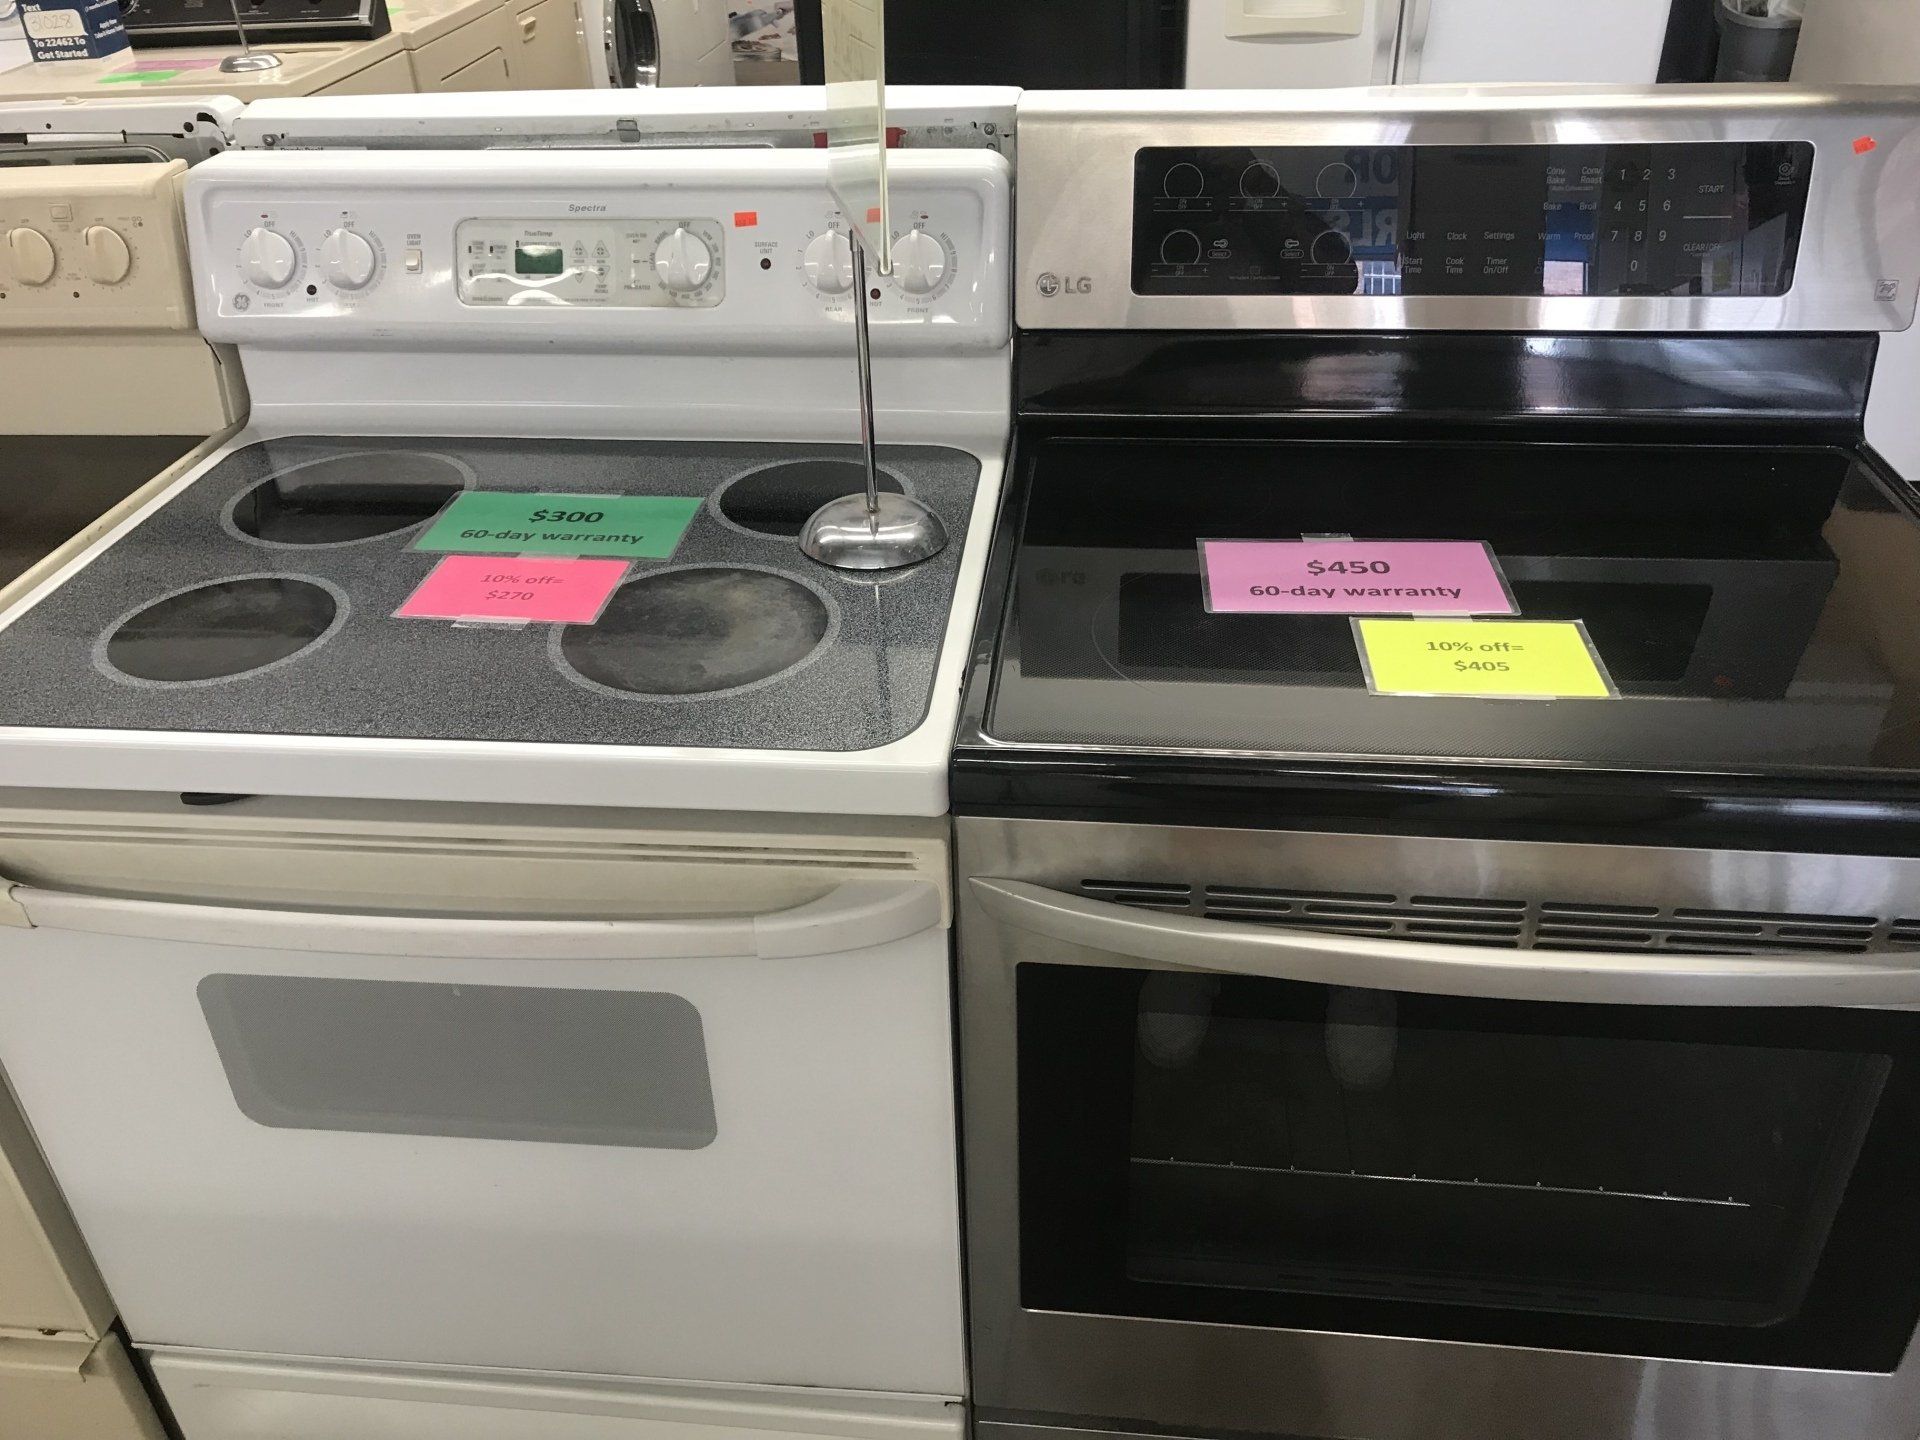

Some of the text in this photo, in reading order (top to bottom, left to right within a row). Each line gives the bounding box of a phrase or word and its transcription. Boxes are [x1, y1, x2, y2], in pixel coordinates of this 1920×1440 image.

[21, 3, 41, 12] Text
[33, 40, 45, 48] To
[74, 37, 86, 45] To
[37, 49, 89, 60] Get Started
[1619, 168, 1676, 180] 1 2 3
[1698, 185, 1725, 194] START
[568, 203, 606, 212] Spectra
[1579, 202, 1597, 211] Broil
[1614, 200, 1671, 212] 4 5 6
[828, 221, 841, 229] OFF
[1406, 232, 1425, 241] Light
[1447, 232, 1467, 240] Clock
[1484, 232, 1515, 241] Settings
[1611, 230, 1667, 241] 7 8 9
[1487, 256, 1508, 265] Timer
[1630, 260, 1638, 271] 0
[1445, 265, 1464, 274] Time
[1065, 276, 1092, 294] LG
[528, 509, 605, 524] $300
[460, 528, 645, 545] 60-day warranty
[1306, 559, 1391, 576] $450
[480, 574, 565, 585] 10% off=
[485, 589, 535, 601] $270
[1249, 585, 1462, 599] 60-day warranty
[1426, 641, 1525, 653] 10% off=
[1453, 659, 1511, 673] $405
